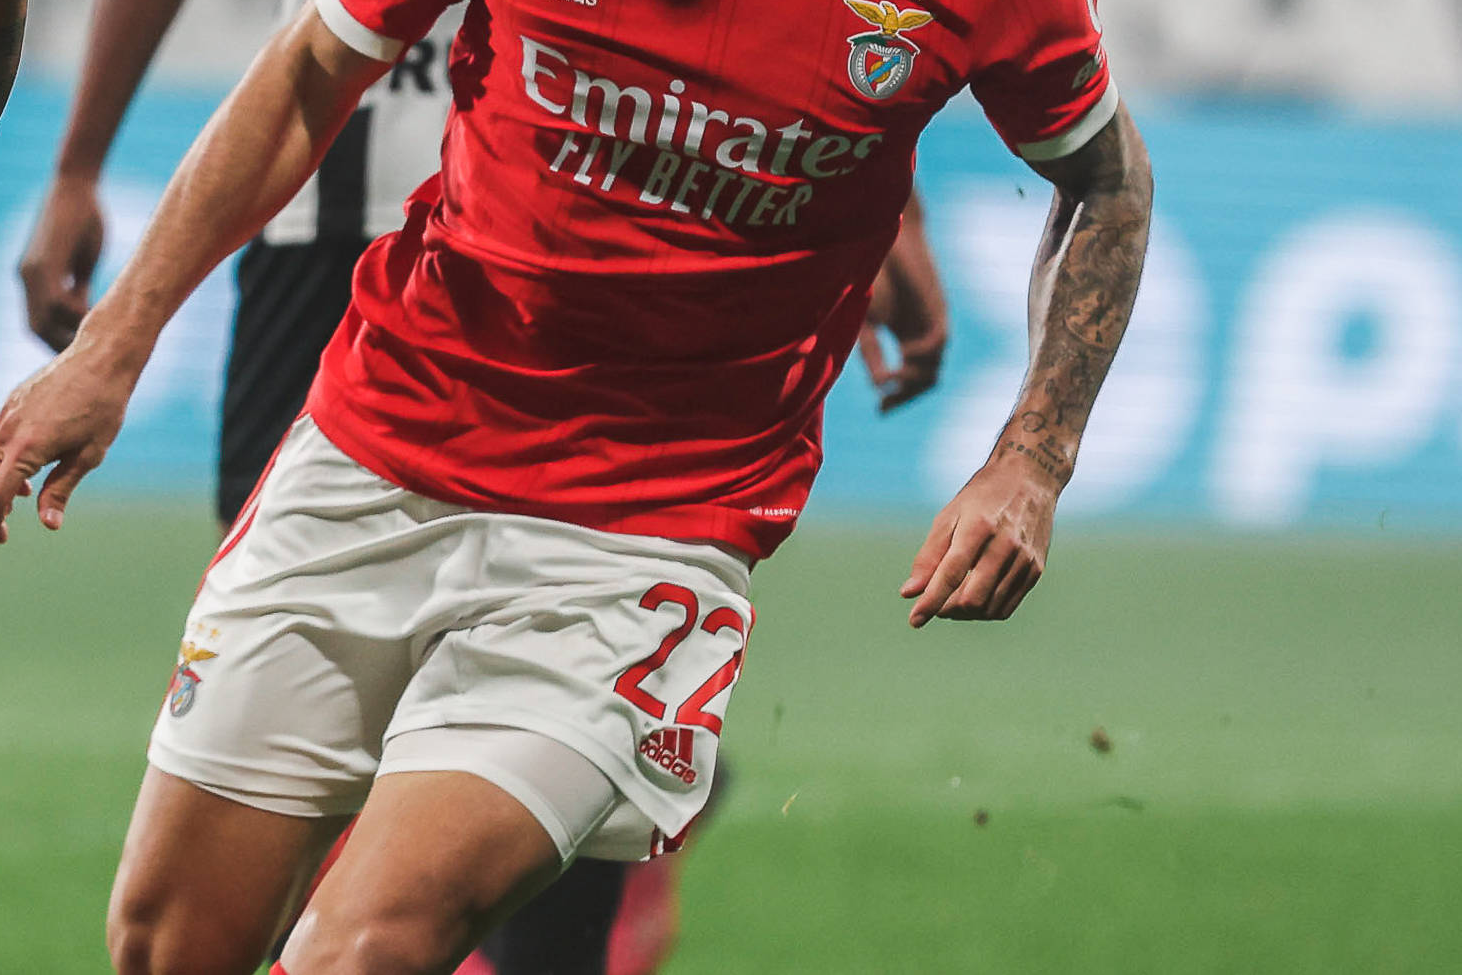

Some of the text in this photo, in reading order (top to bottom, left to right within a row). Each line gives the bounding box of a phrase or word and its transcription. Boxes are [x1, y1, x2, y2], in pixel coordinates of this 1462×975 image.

[549, 130, 813, 225] FLY BETTER
[614, 582, 744, 738] 22
